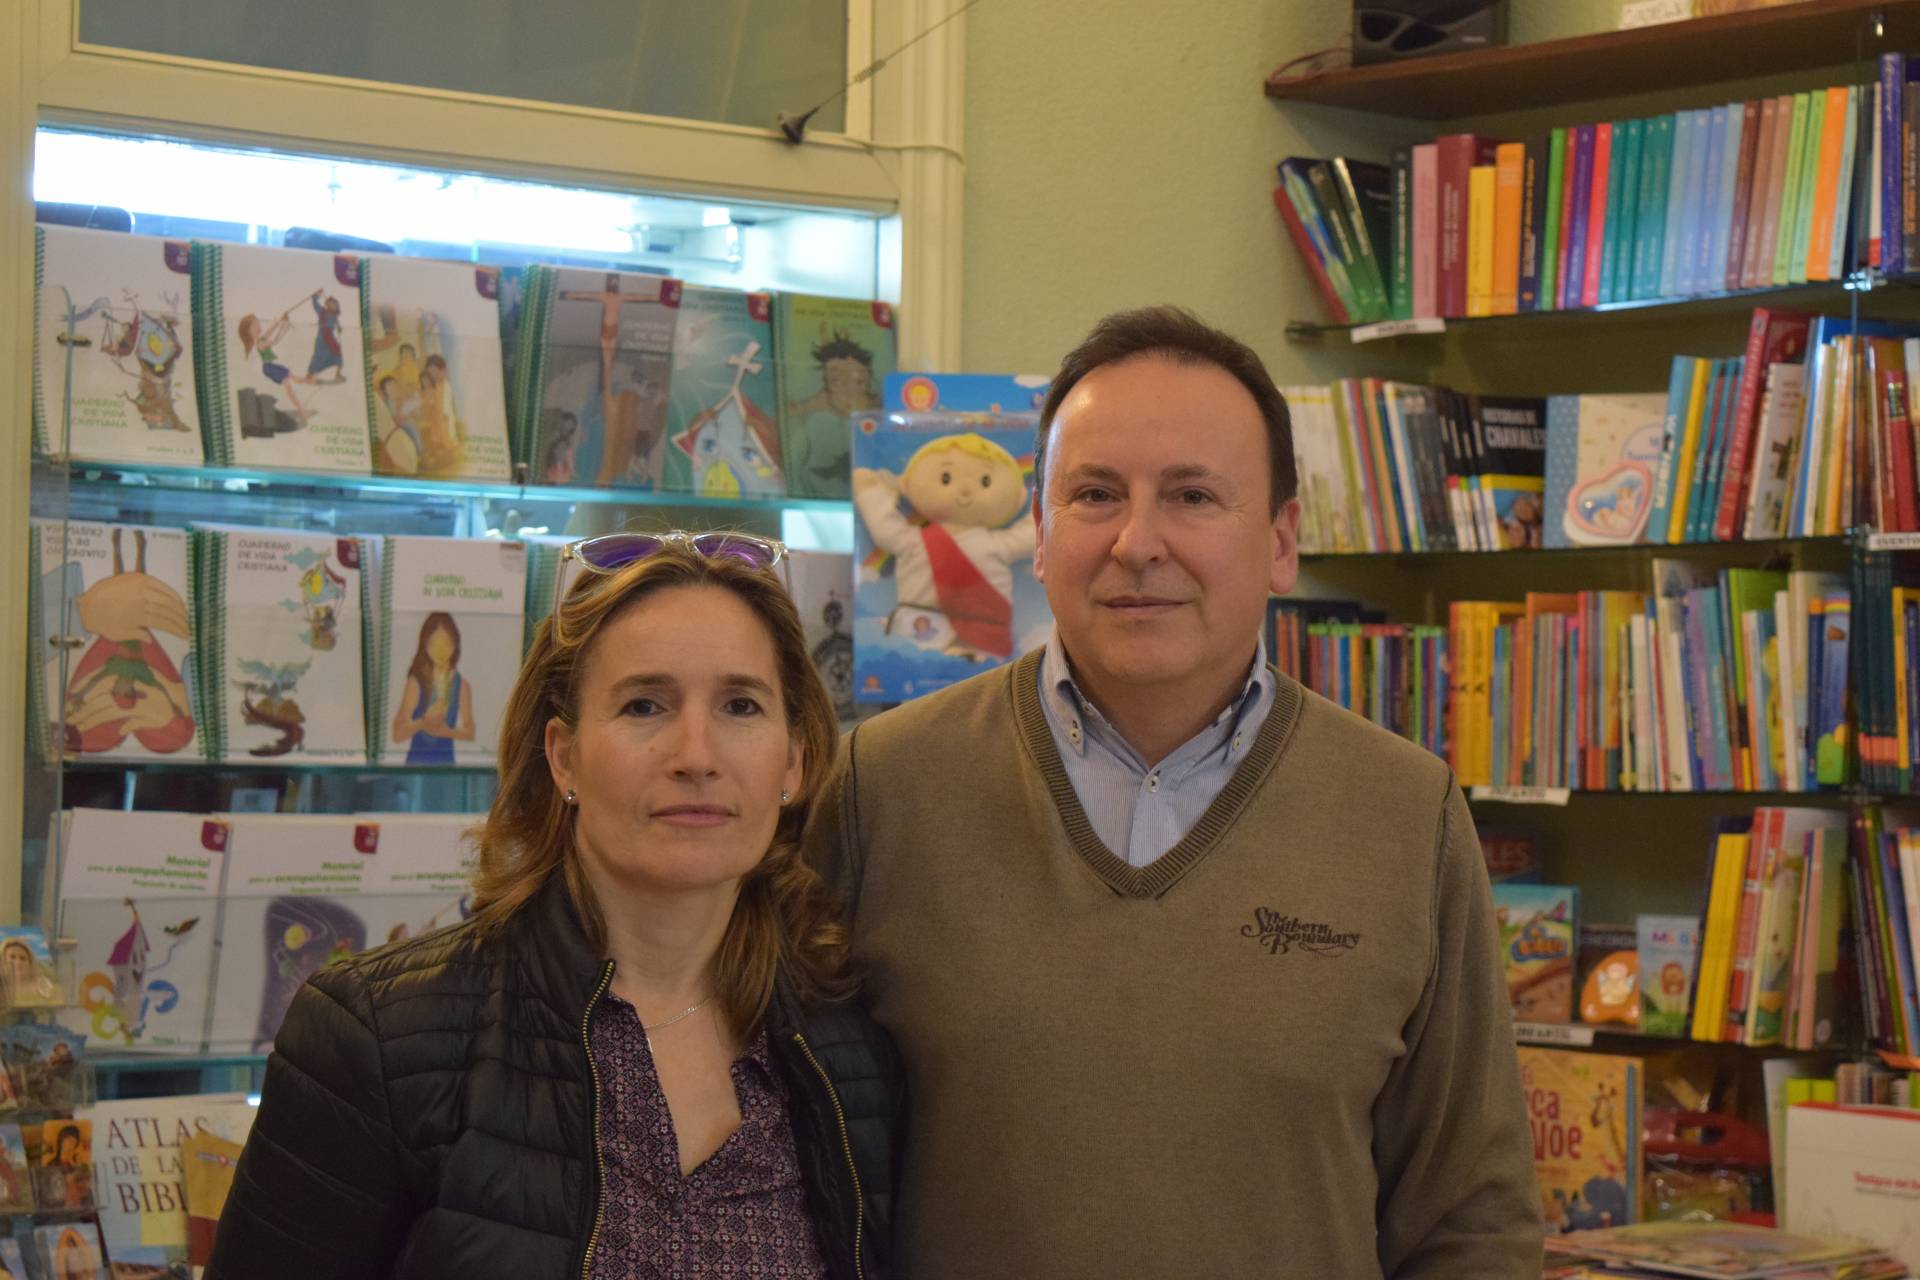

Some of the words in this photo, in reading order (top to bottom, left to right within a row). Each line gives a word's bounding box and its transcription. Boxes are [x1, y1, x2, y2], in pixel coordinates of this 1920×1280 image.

[73, 397, 126, 408] UADERNO
[310, 423, 364, 435] CUADERNO
[238, 539, 291, 551] CUADERNO
[238, 551, 250, 560] DE
[254, 552, 277, 561] VIDA
[238, 560, 288, 573] CRISTIANA
[167, 853, 211, 870] Material
[321, 860, 365, 870] Material
[1240, 907, 1329, 937] Southern
[1260, 929, 1361, 958] Boundary
[1524, 1088, 1560, 1119] ca
[111, 1156, 142, 1175] DE
[157, 1155, 184, 1174] LA
